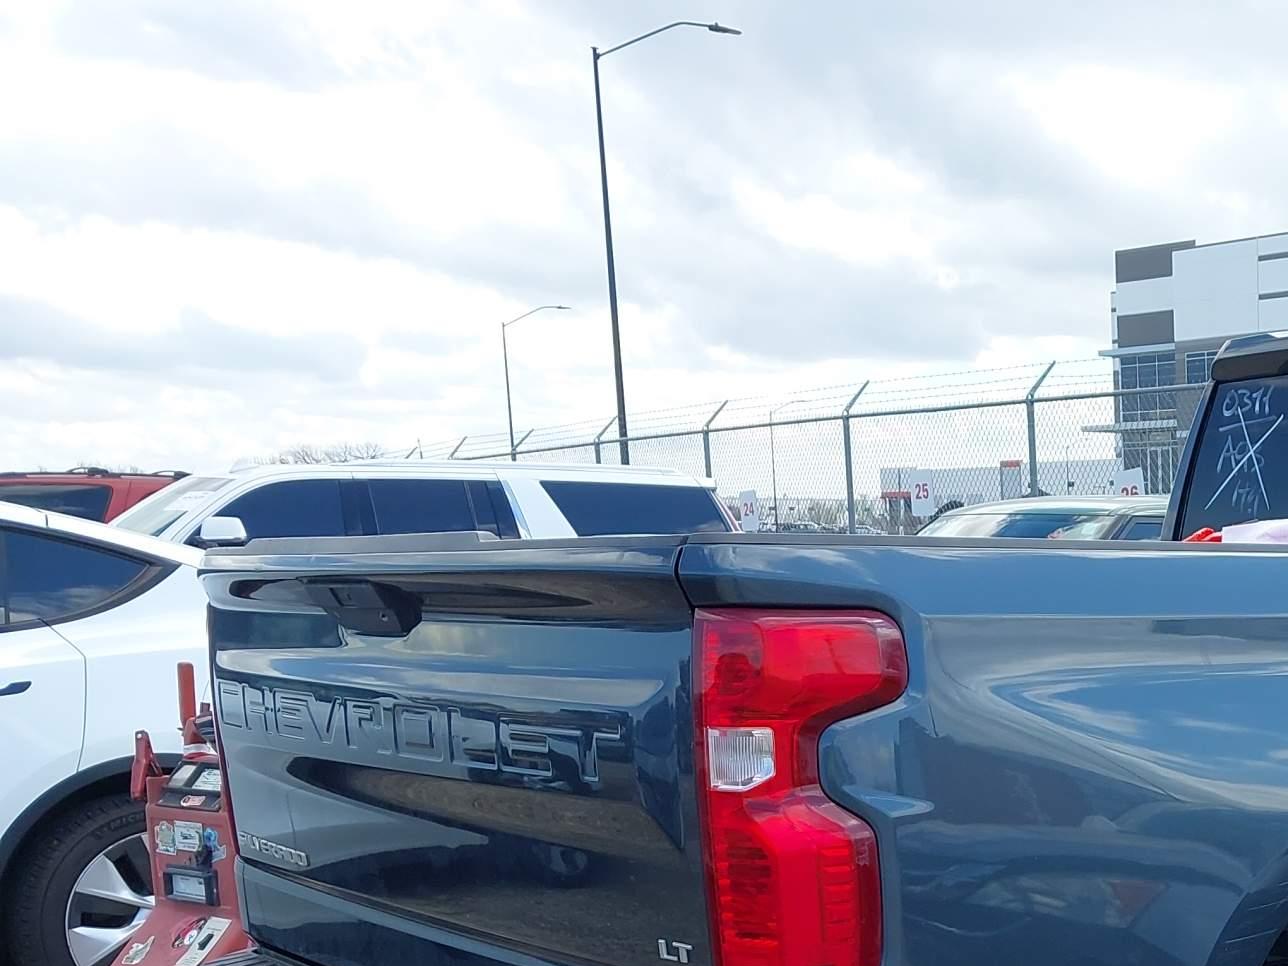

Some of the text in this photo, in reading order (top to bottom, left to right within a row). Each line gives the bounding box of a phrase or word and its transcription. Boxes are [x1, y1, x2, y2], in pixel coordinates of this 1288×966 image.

[914, 482, 930, 500] 25
[743, 502, 756, 517] 24
[216, 678, 622, 783] CHEVROLET
[657, 938, 693, 964] LT
